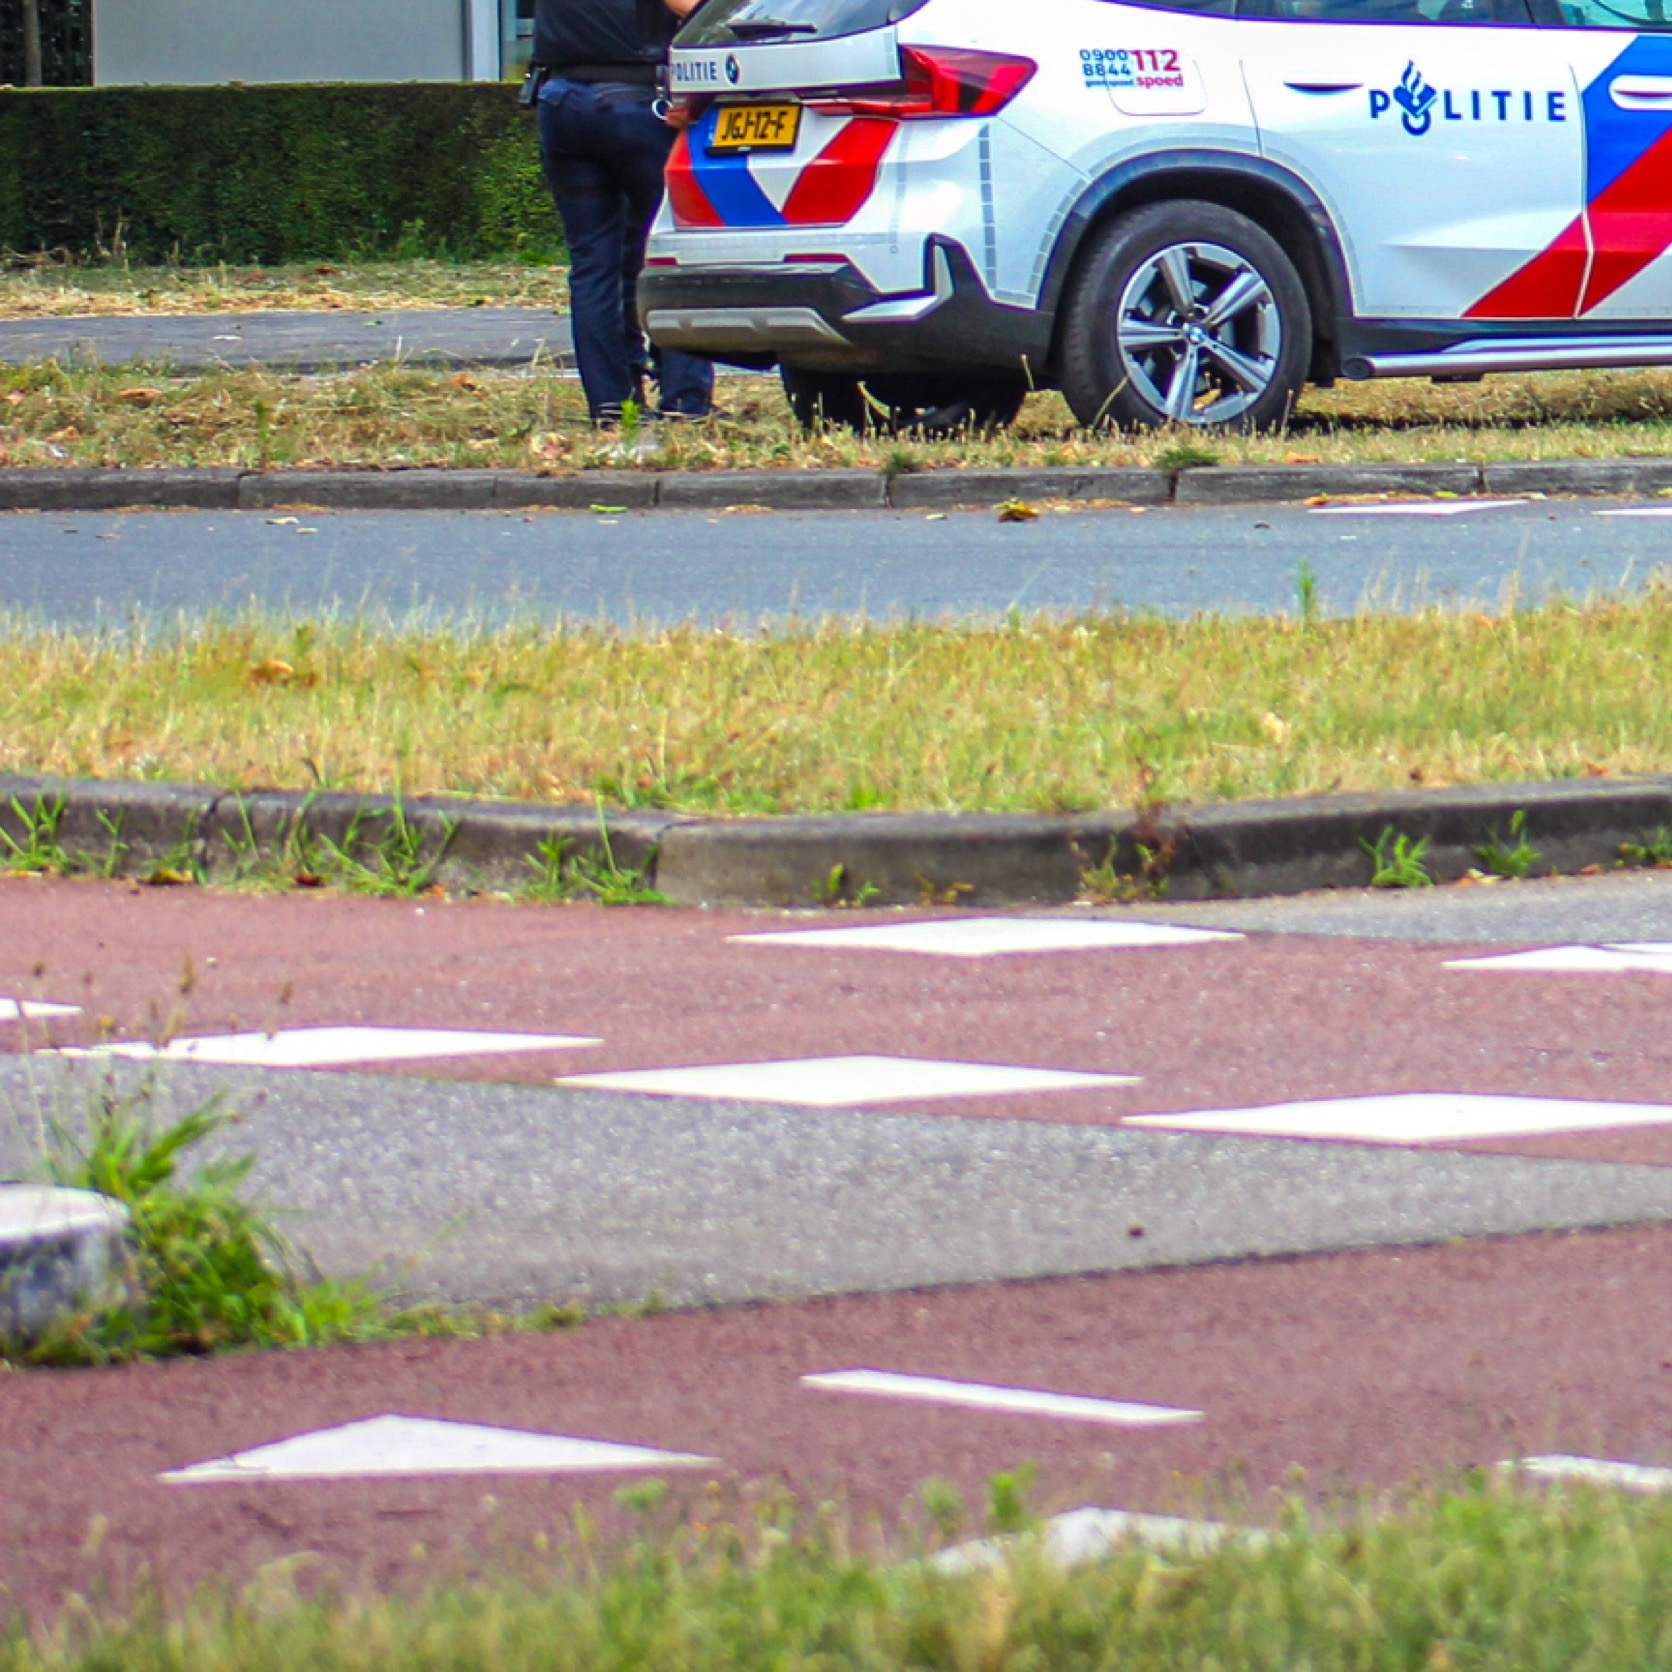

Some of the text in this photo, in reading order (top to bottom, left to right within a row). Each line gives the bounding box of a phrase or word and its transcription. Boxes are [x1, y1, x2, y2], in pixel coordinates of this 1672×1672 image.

[1080, 49, 1181, 72] 0900 112
[1082, 63, 1131, 76] 8844
[1136, 73, 1184, 89] spoed
[721, 109, 789, 141] JGJ-12-F
